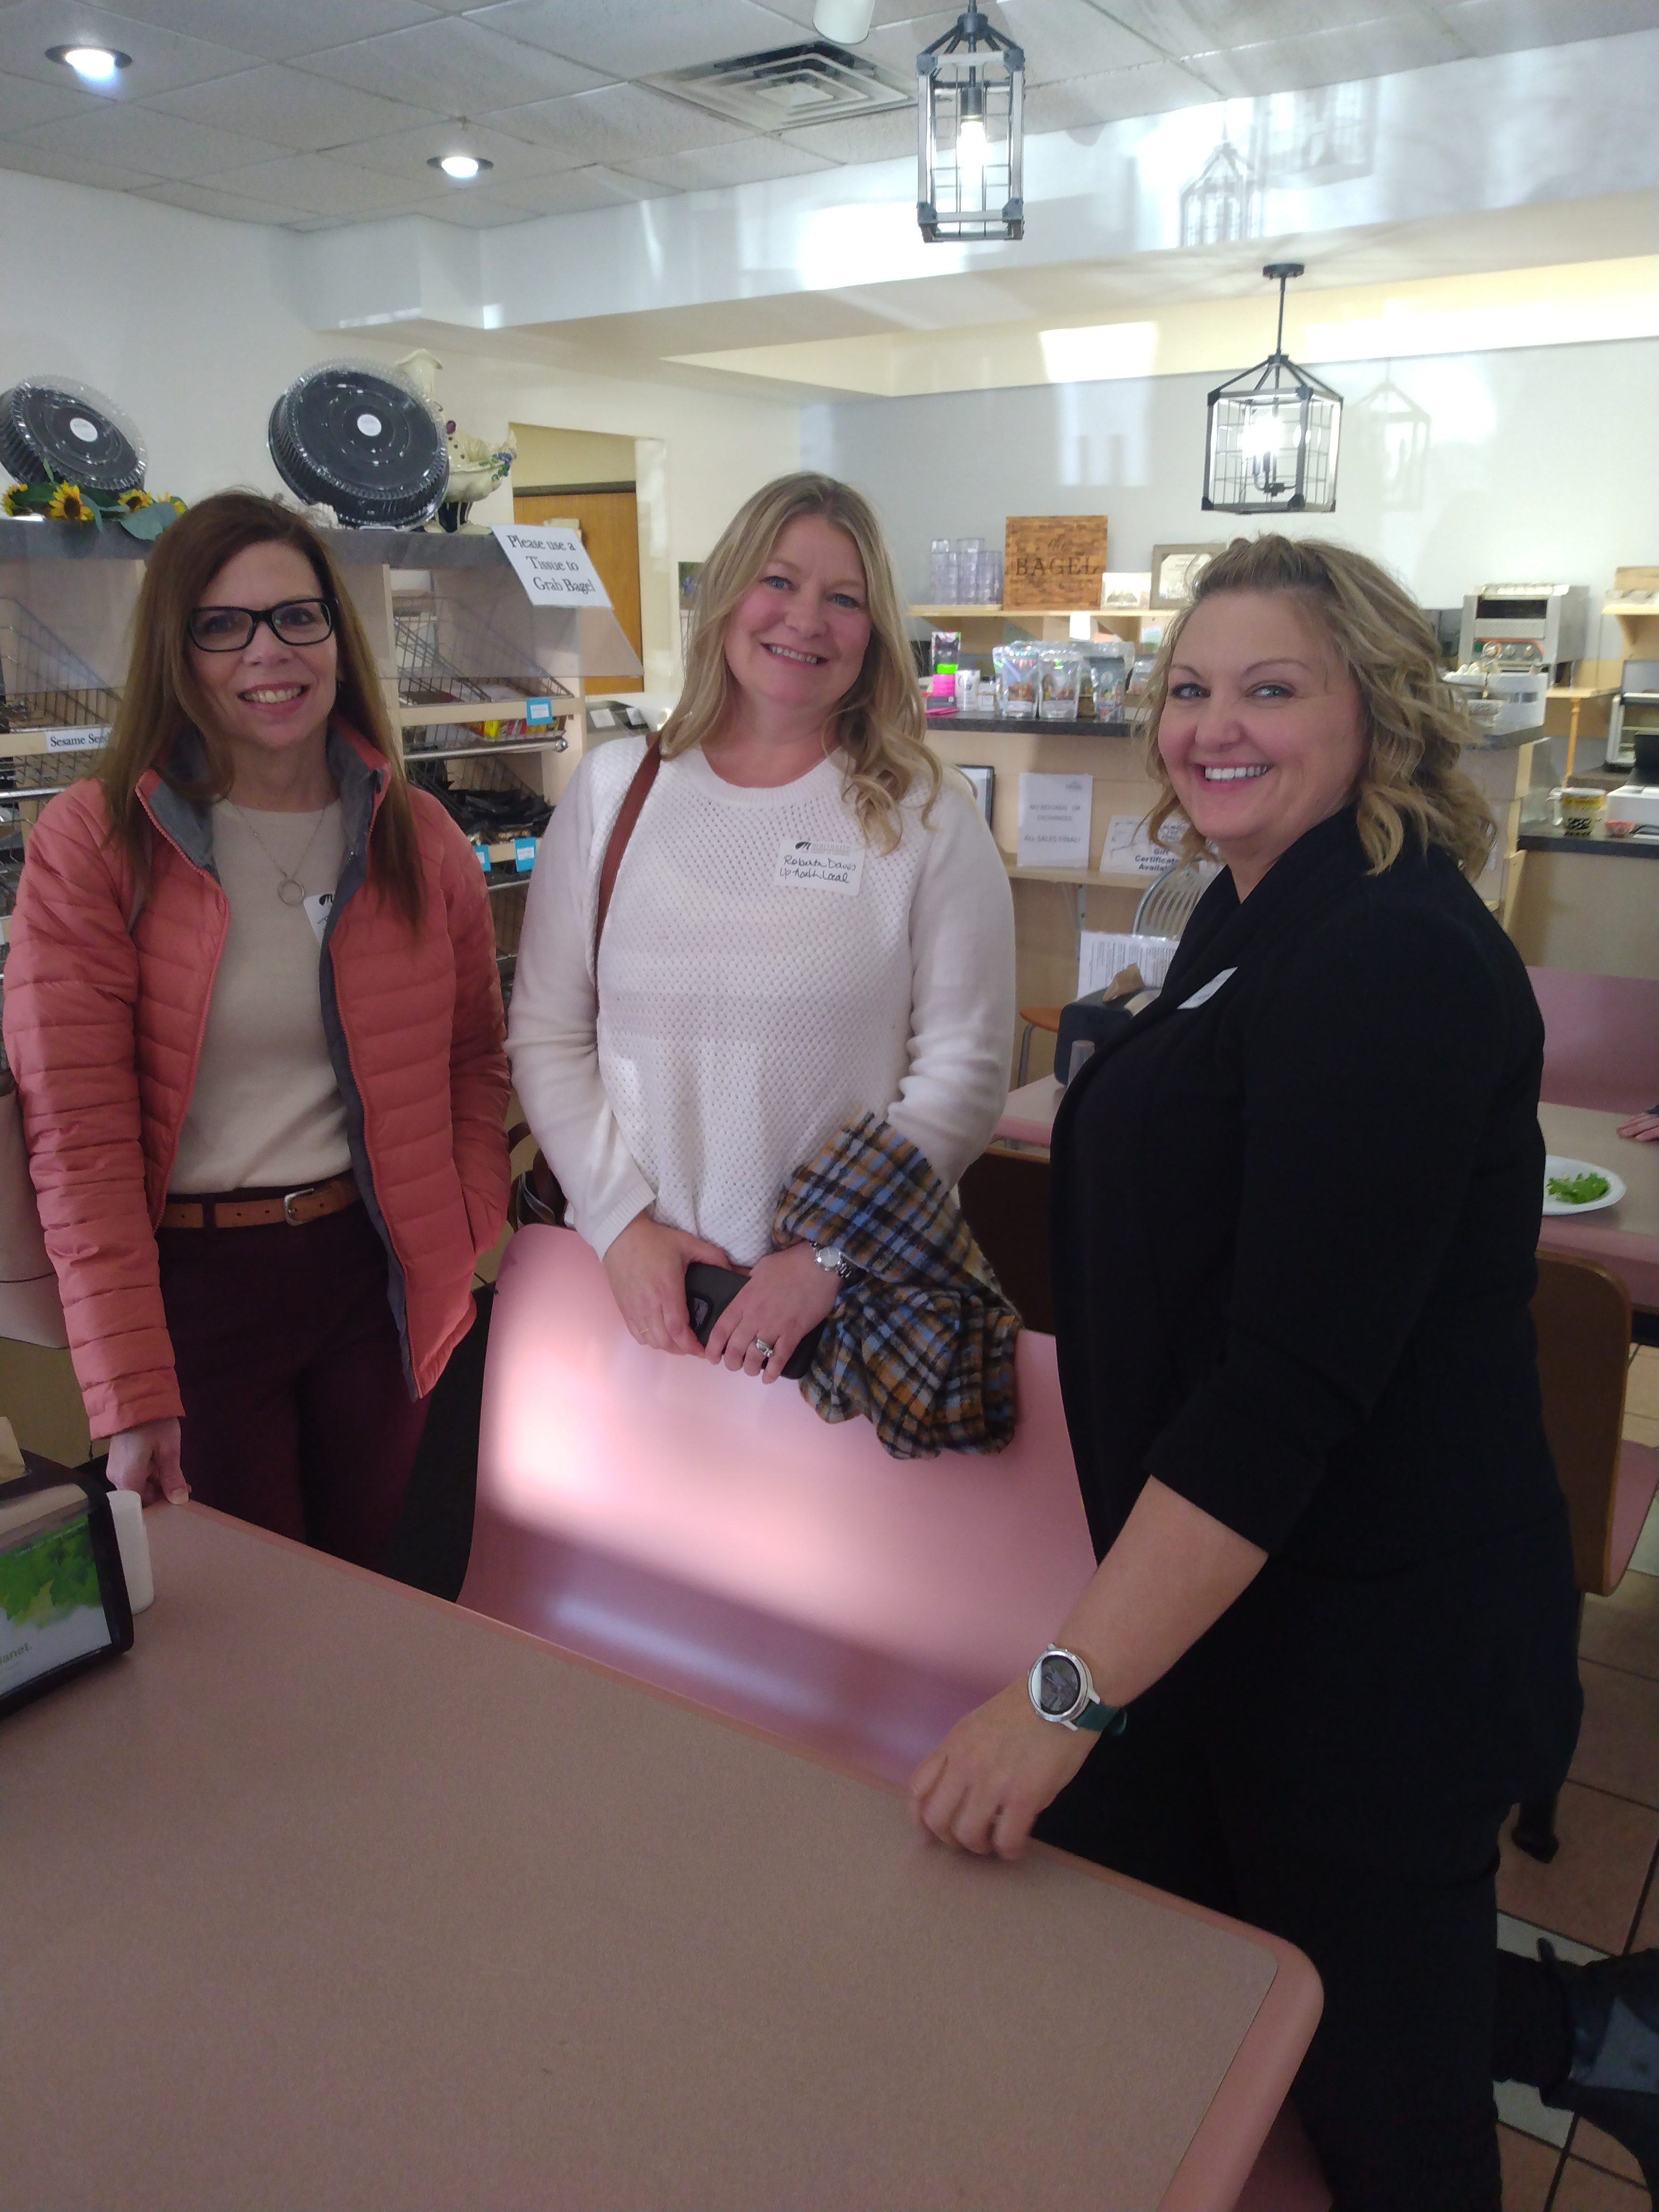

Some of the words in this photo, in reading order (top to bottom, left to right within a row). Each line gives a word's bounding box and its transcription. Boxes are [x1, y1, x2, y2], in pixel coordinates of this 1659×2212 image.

[506, 534, 546, 550] Please
[547, 541, 566, 551] use
[567, 542, 576, 551] a
[525, 556, 566, 571] Tissue
[565, 560, 579, 571] to
[1016, 557, 1099, 575] BAGEL
[533, 576, 564, 591] Grab
[562, 578, 596, 594] Bagel
[50, 735, 86, 747] Sesame
